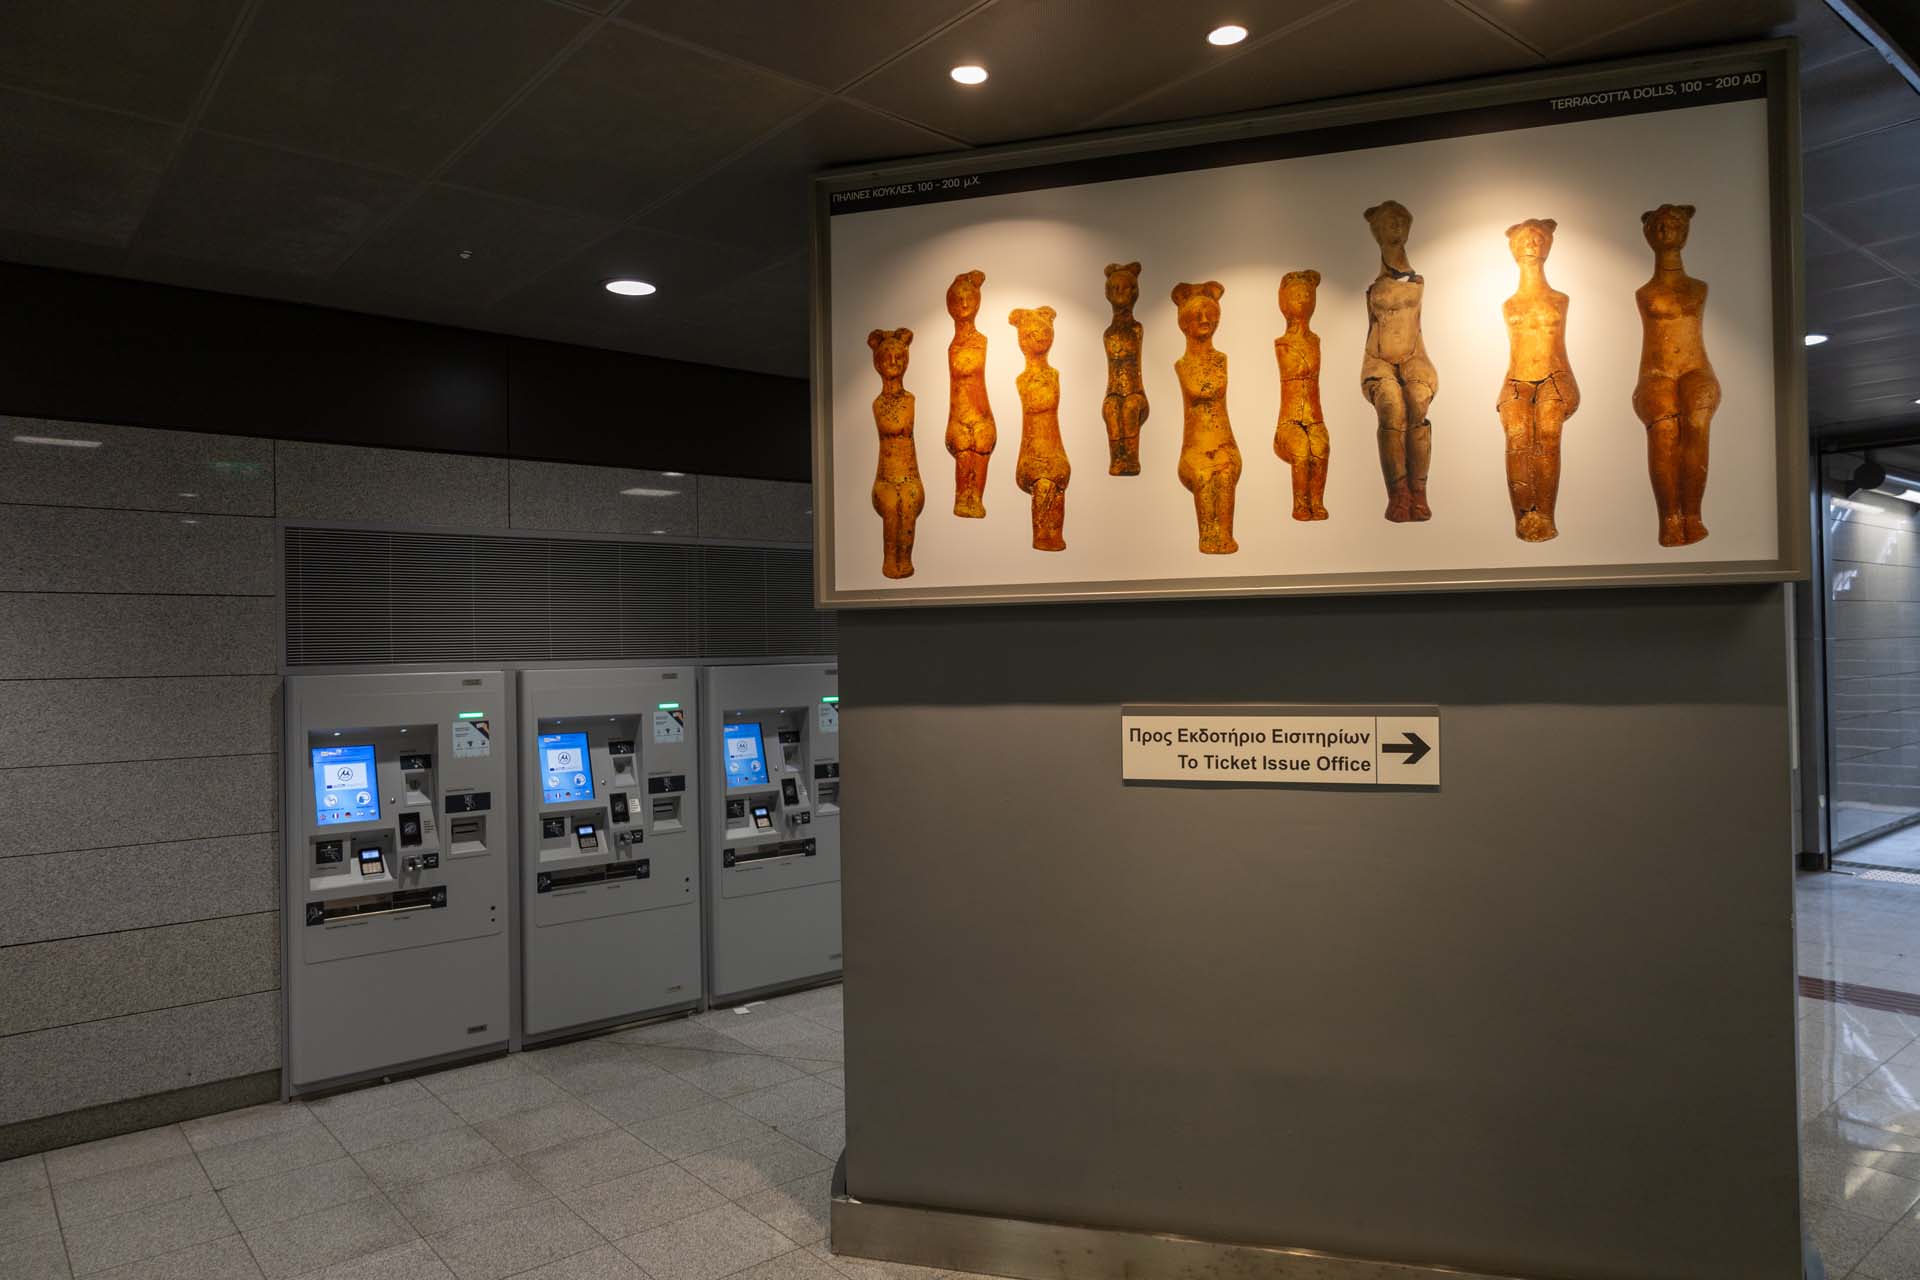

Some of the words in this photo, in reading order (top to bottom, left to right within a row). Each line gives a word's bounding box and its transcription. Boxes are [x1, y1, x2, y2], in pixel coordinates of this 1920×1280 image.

[1551, 90, 1631, 110] TERRACOTTA
[1633, 84, 1677, 100] DOLLS,
[1681, 80, 1702, 93] 100
[1715, 76, 1740, 89] 200
[1743, 73, 1761, 85] AD
[832, 189, 872, 203] ΠΗΛΙΝΕΣ
[918, 182, 933, 192] 100
[942, 178, 960, 189] 200
[1129, 728, 1172, 745] Προς
[1177, 727, 1266, 746] Εκδοτήριο
[1272, 728, 1370, 746] Εισιτηρίων
[1178, 755, 1198, 769] To
[1204, 755, 1257, 770] Ticket
[1263, 755, 1310, 771] Issue
[1316, 756, 1371, 772] Office
